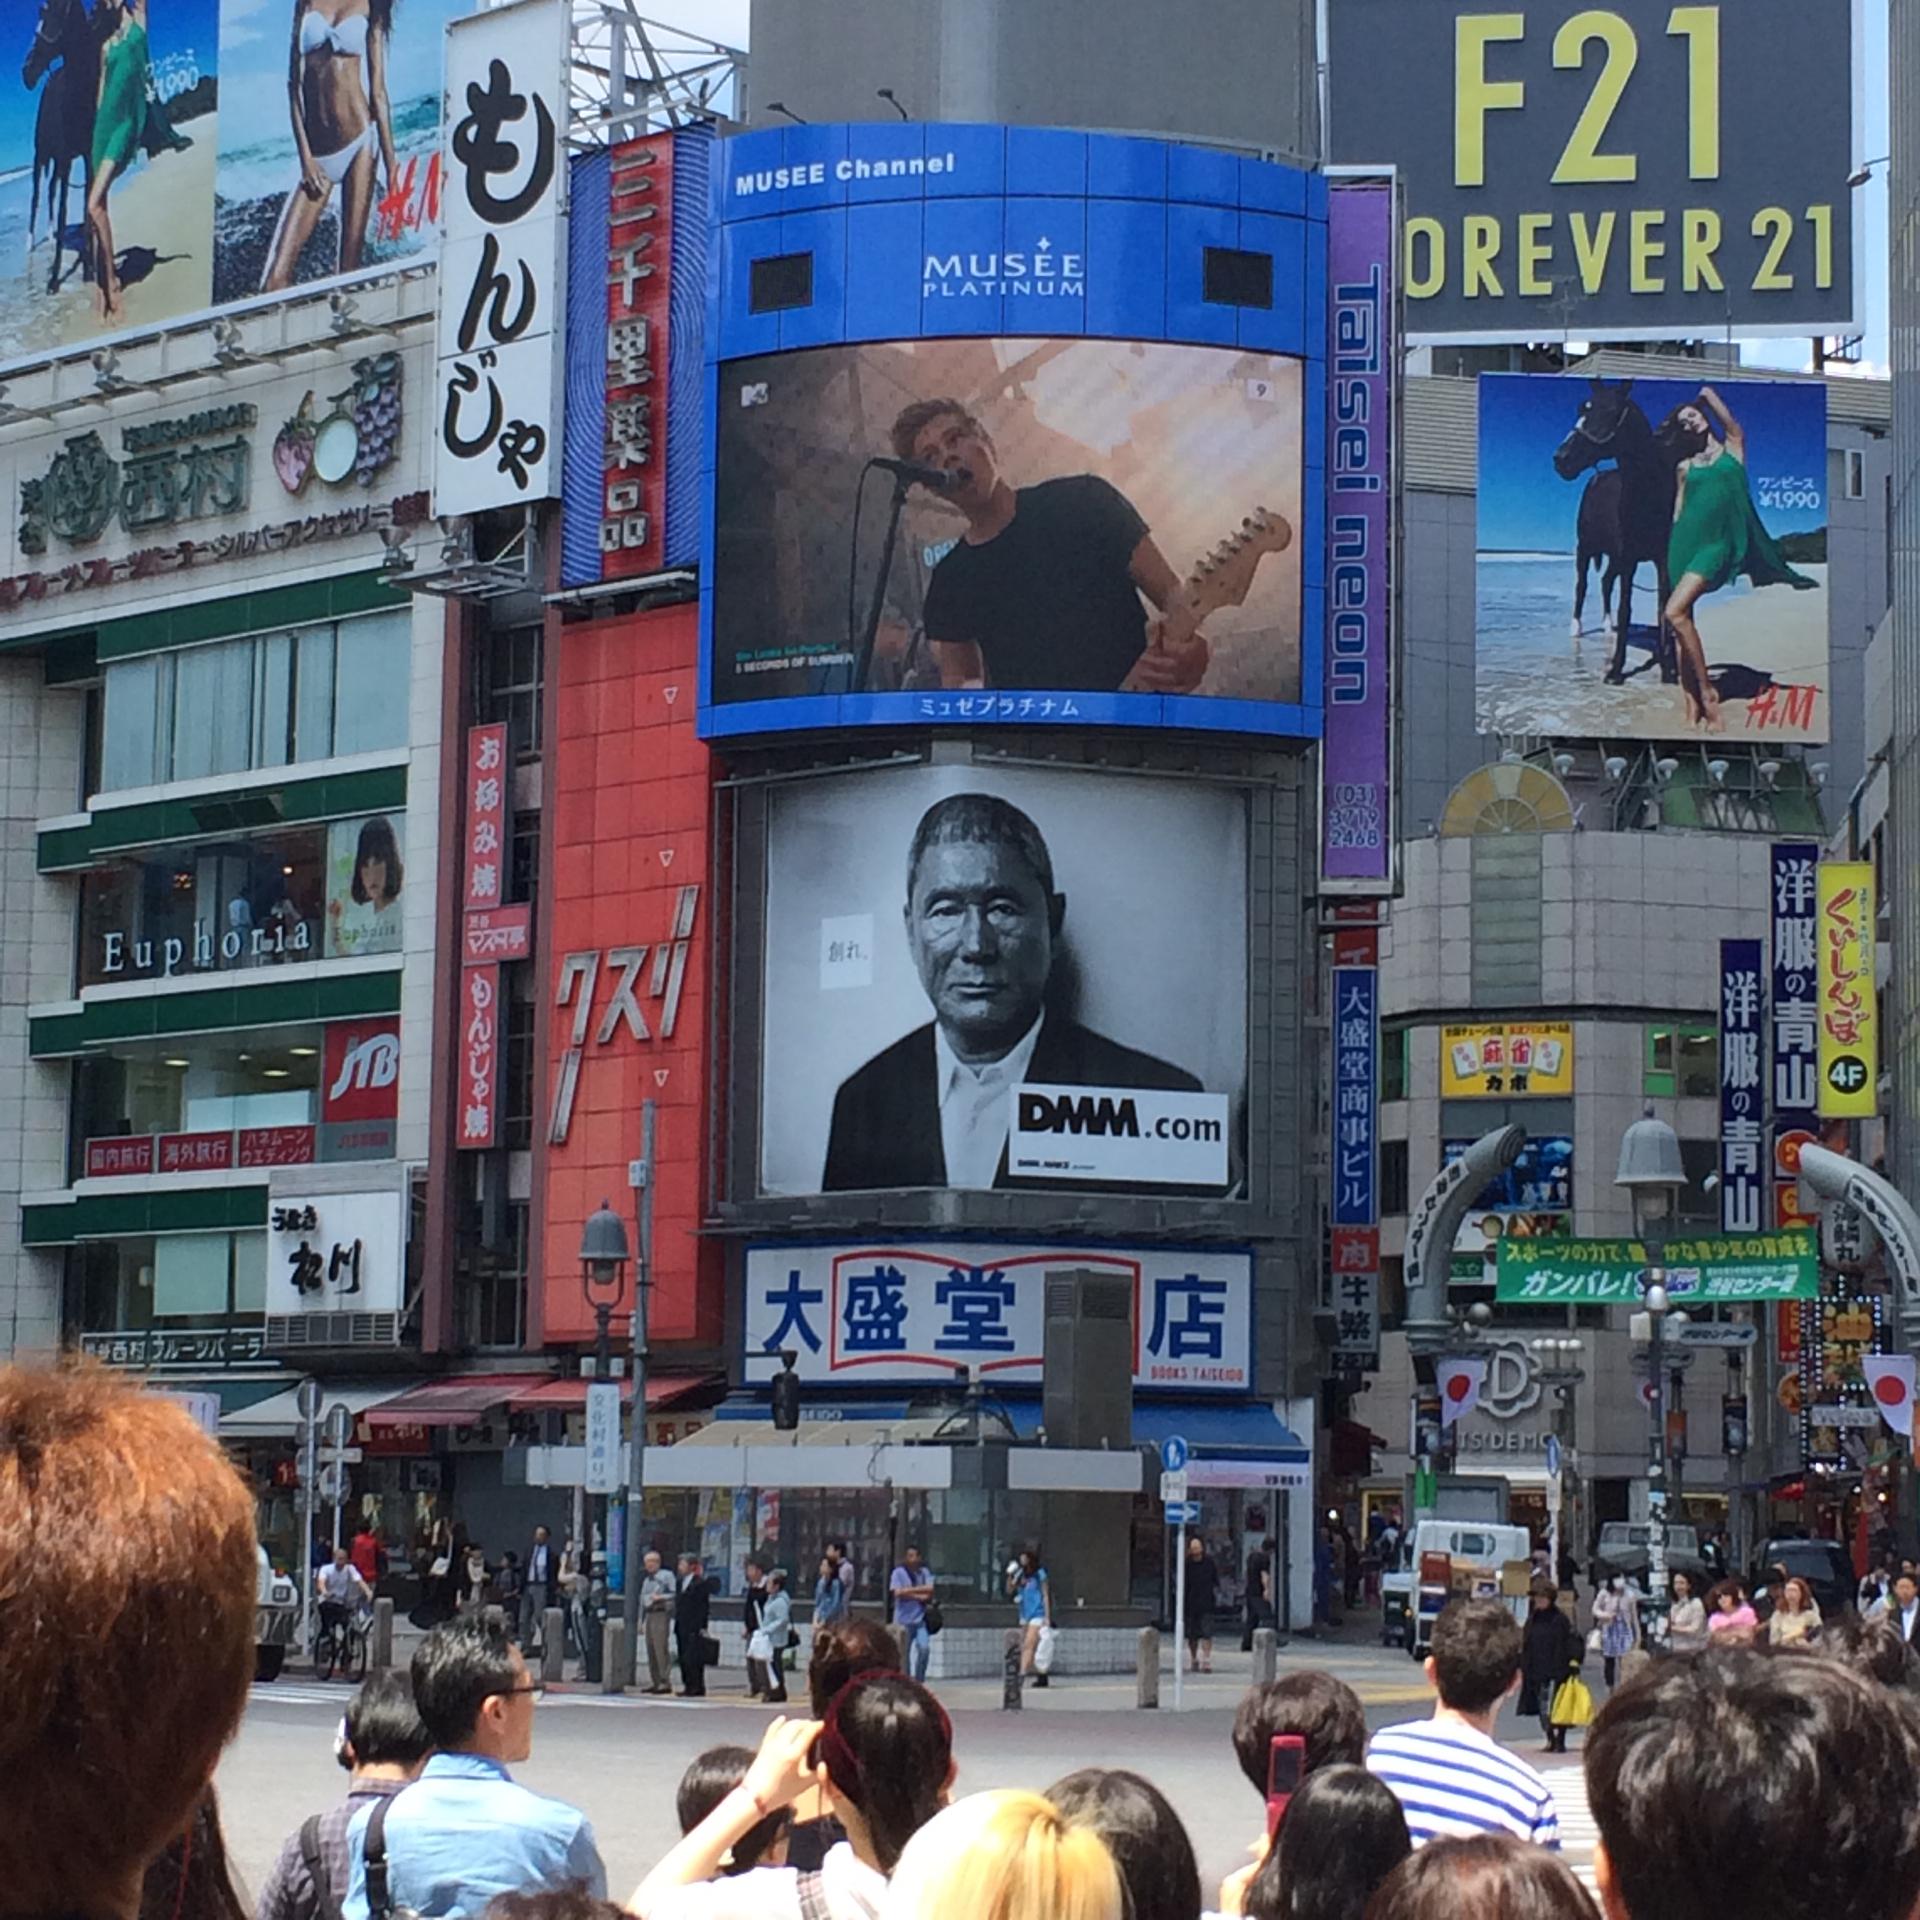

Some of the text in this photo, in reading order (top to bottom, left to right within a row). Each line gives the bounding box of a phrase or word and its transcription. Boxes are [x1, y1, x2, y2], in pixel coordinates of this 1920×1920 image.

[1455, 7, 1719, 186] F21
[736, 152, 955, 196] MUSEE Channel
[444, 58, 556, 489] もんじゃ
[1404, 204, 1833, 299] OREVER 21
[923, 280, 1084, 298] PLATINUM
[602, 148, 657, 554] 三千里薬品
[1332, 264, 1380, 705] Taisei neon
[1758, 476, 1815, 490] ワンピース
[1758, 491, 1820, 510] ¥1,990
[920, 697, 1079, 717] ミュゼプラチナム
[1745, 683, 1816, 732] H&M
[471, 736, 501, 897] お好み焼
[1335, 785, 1376, 804] (03)
[1329, 829, 1380, 848] 2468
[102, 917, 311, 978] Euphoria
[1825, 888, 1870, 1046] くいしんぼ
[1775, 859, 1817, 1109] 洋服の青山
[330, 1033, 400, 1101] JTB
[1482, 1038, 1531, 1065] 麻雀
[1830, 1061, 1864, 1087] 4F
[1018, 1092, 1221, 1142] DMM.com
[1339, 985, 1370, 1208] 大盛堂商事ビル
[1722, 971, 1762, 1233] 洋服の青山
[90, 1145, 151, 1171] 国内旅行
[164, 1139, 228, 1167] 海外旅行
[272, 1205, 318, 1231] うなぎ
[763, 1266, 1228, 1360] 大盛堂店
[1150, 1365, 1188, 1382] BOOKS
